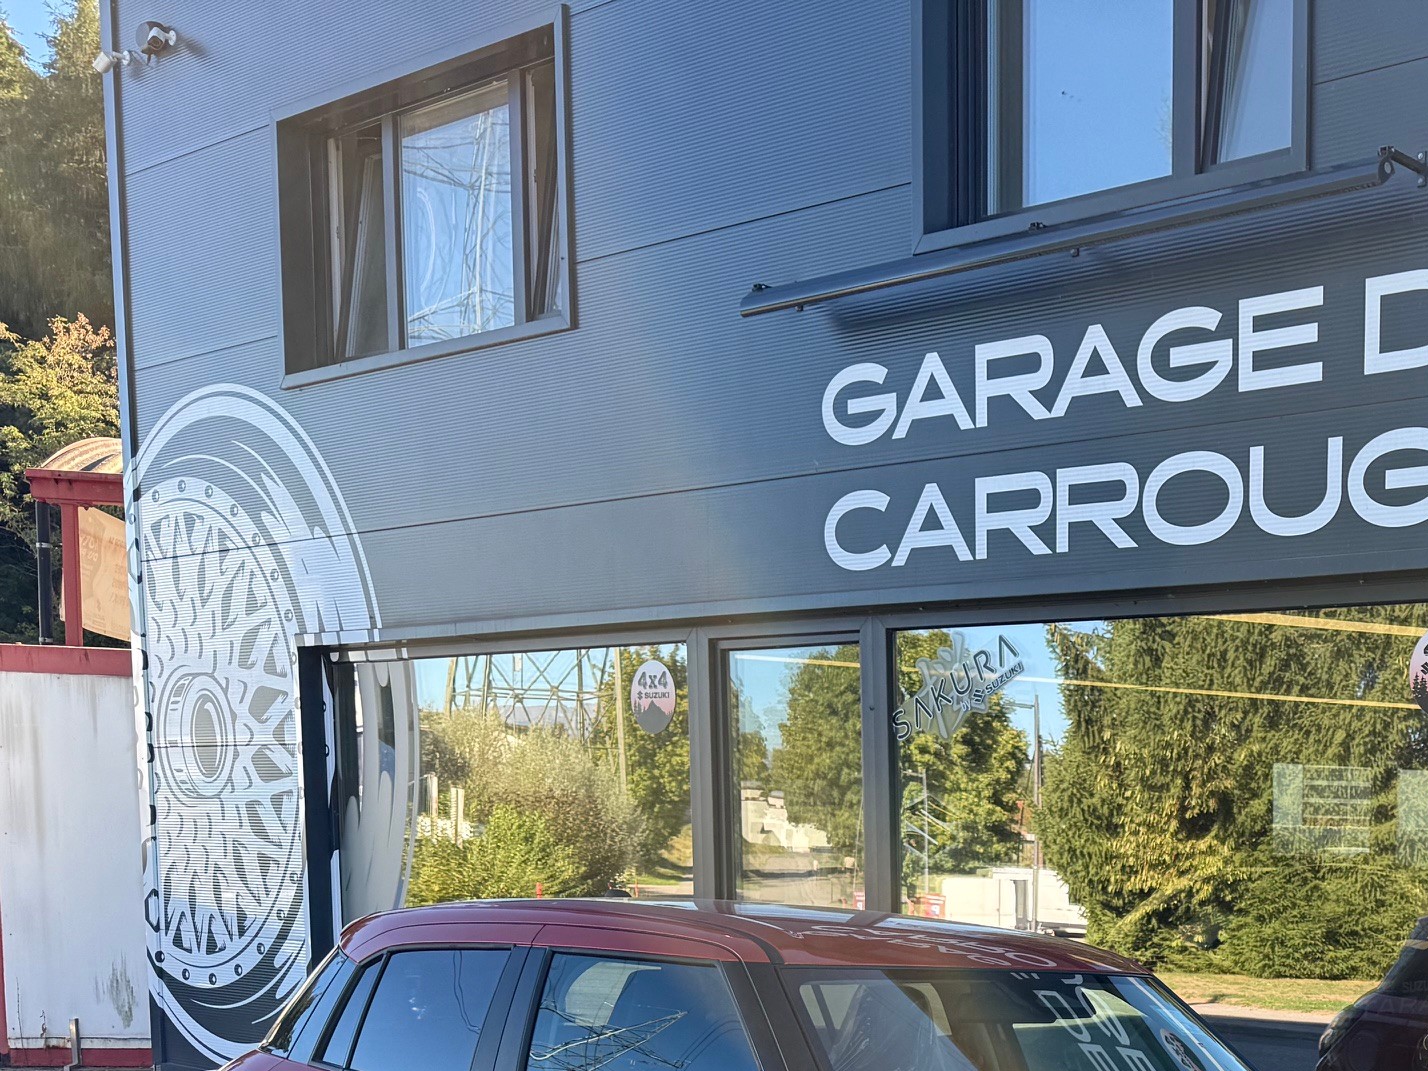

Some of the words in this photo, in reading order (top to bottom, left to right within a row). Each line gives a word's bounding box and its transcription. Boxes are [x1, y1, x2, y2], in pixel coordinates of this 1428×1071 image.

[821, 285, 1324, 447] GARAGE
[637, 670, 668, 690] 4x4
[892, 634, 1020, 741] SAKURA
[985, 661, 1025, 694] SUZUKI
[644, 691, 670, 699] SUZUKI
